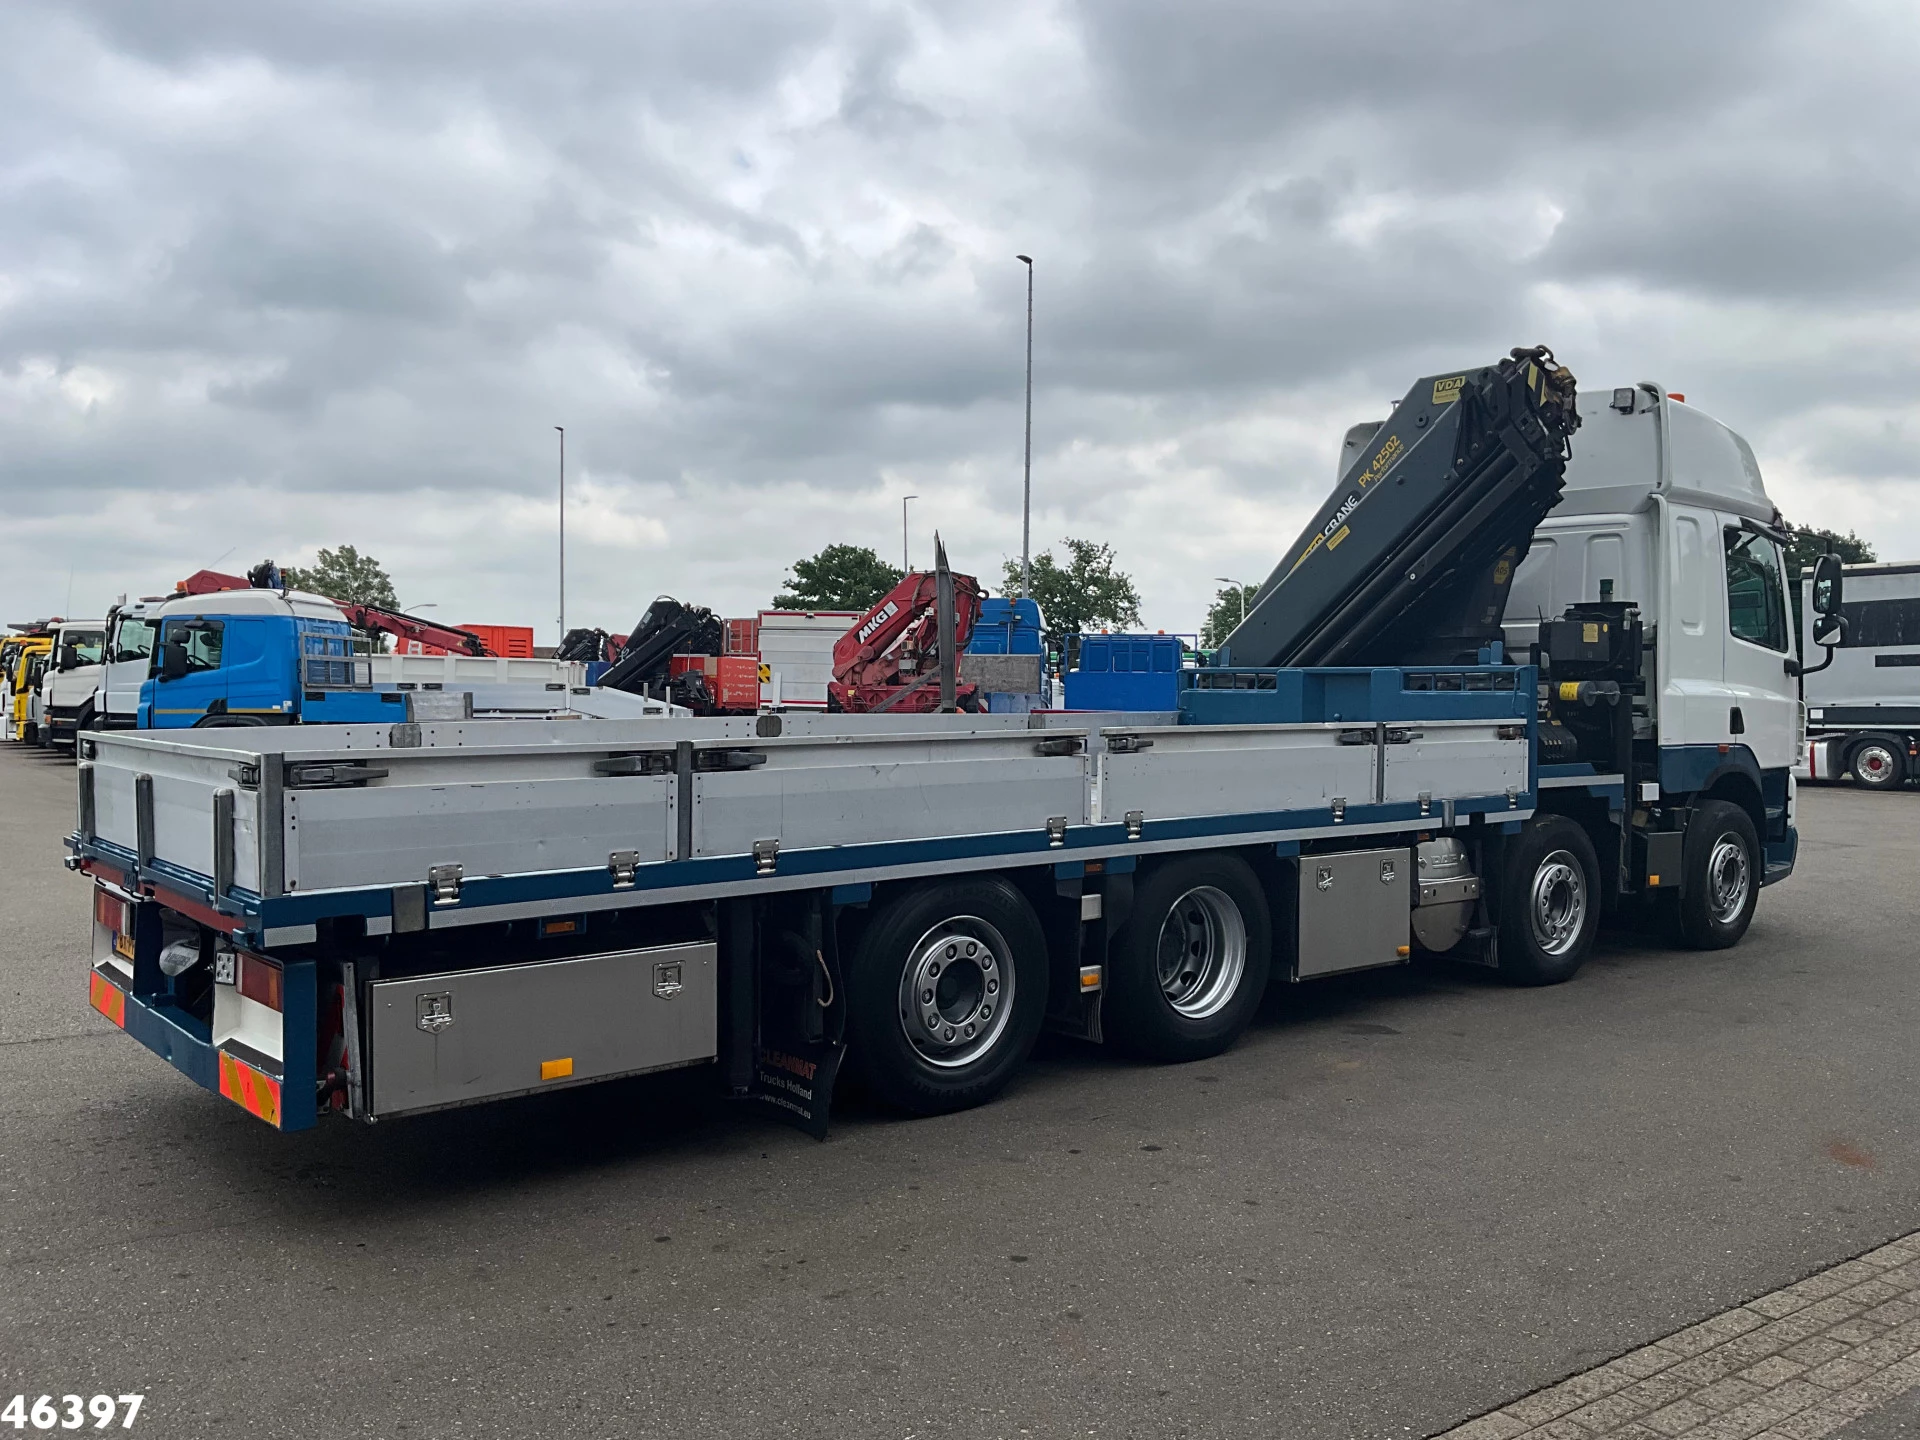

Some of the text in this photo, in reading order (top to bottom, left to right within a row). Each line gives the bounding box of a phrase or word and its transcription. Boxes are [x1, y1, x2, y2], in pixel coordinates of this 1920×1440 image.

[1437, 378, 1463, 391] VDA
[1358, 435, 1400, 488] PK 42502
[1324, 495, 1358, 536] CRANE
[760, 1071, 812, 1101] Trucks Holland
